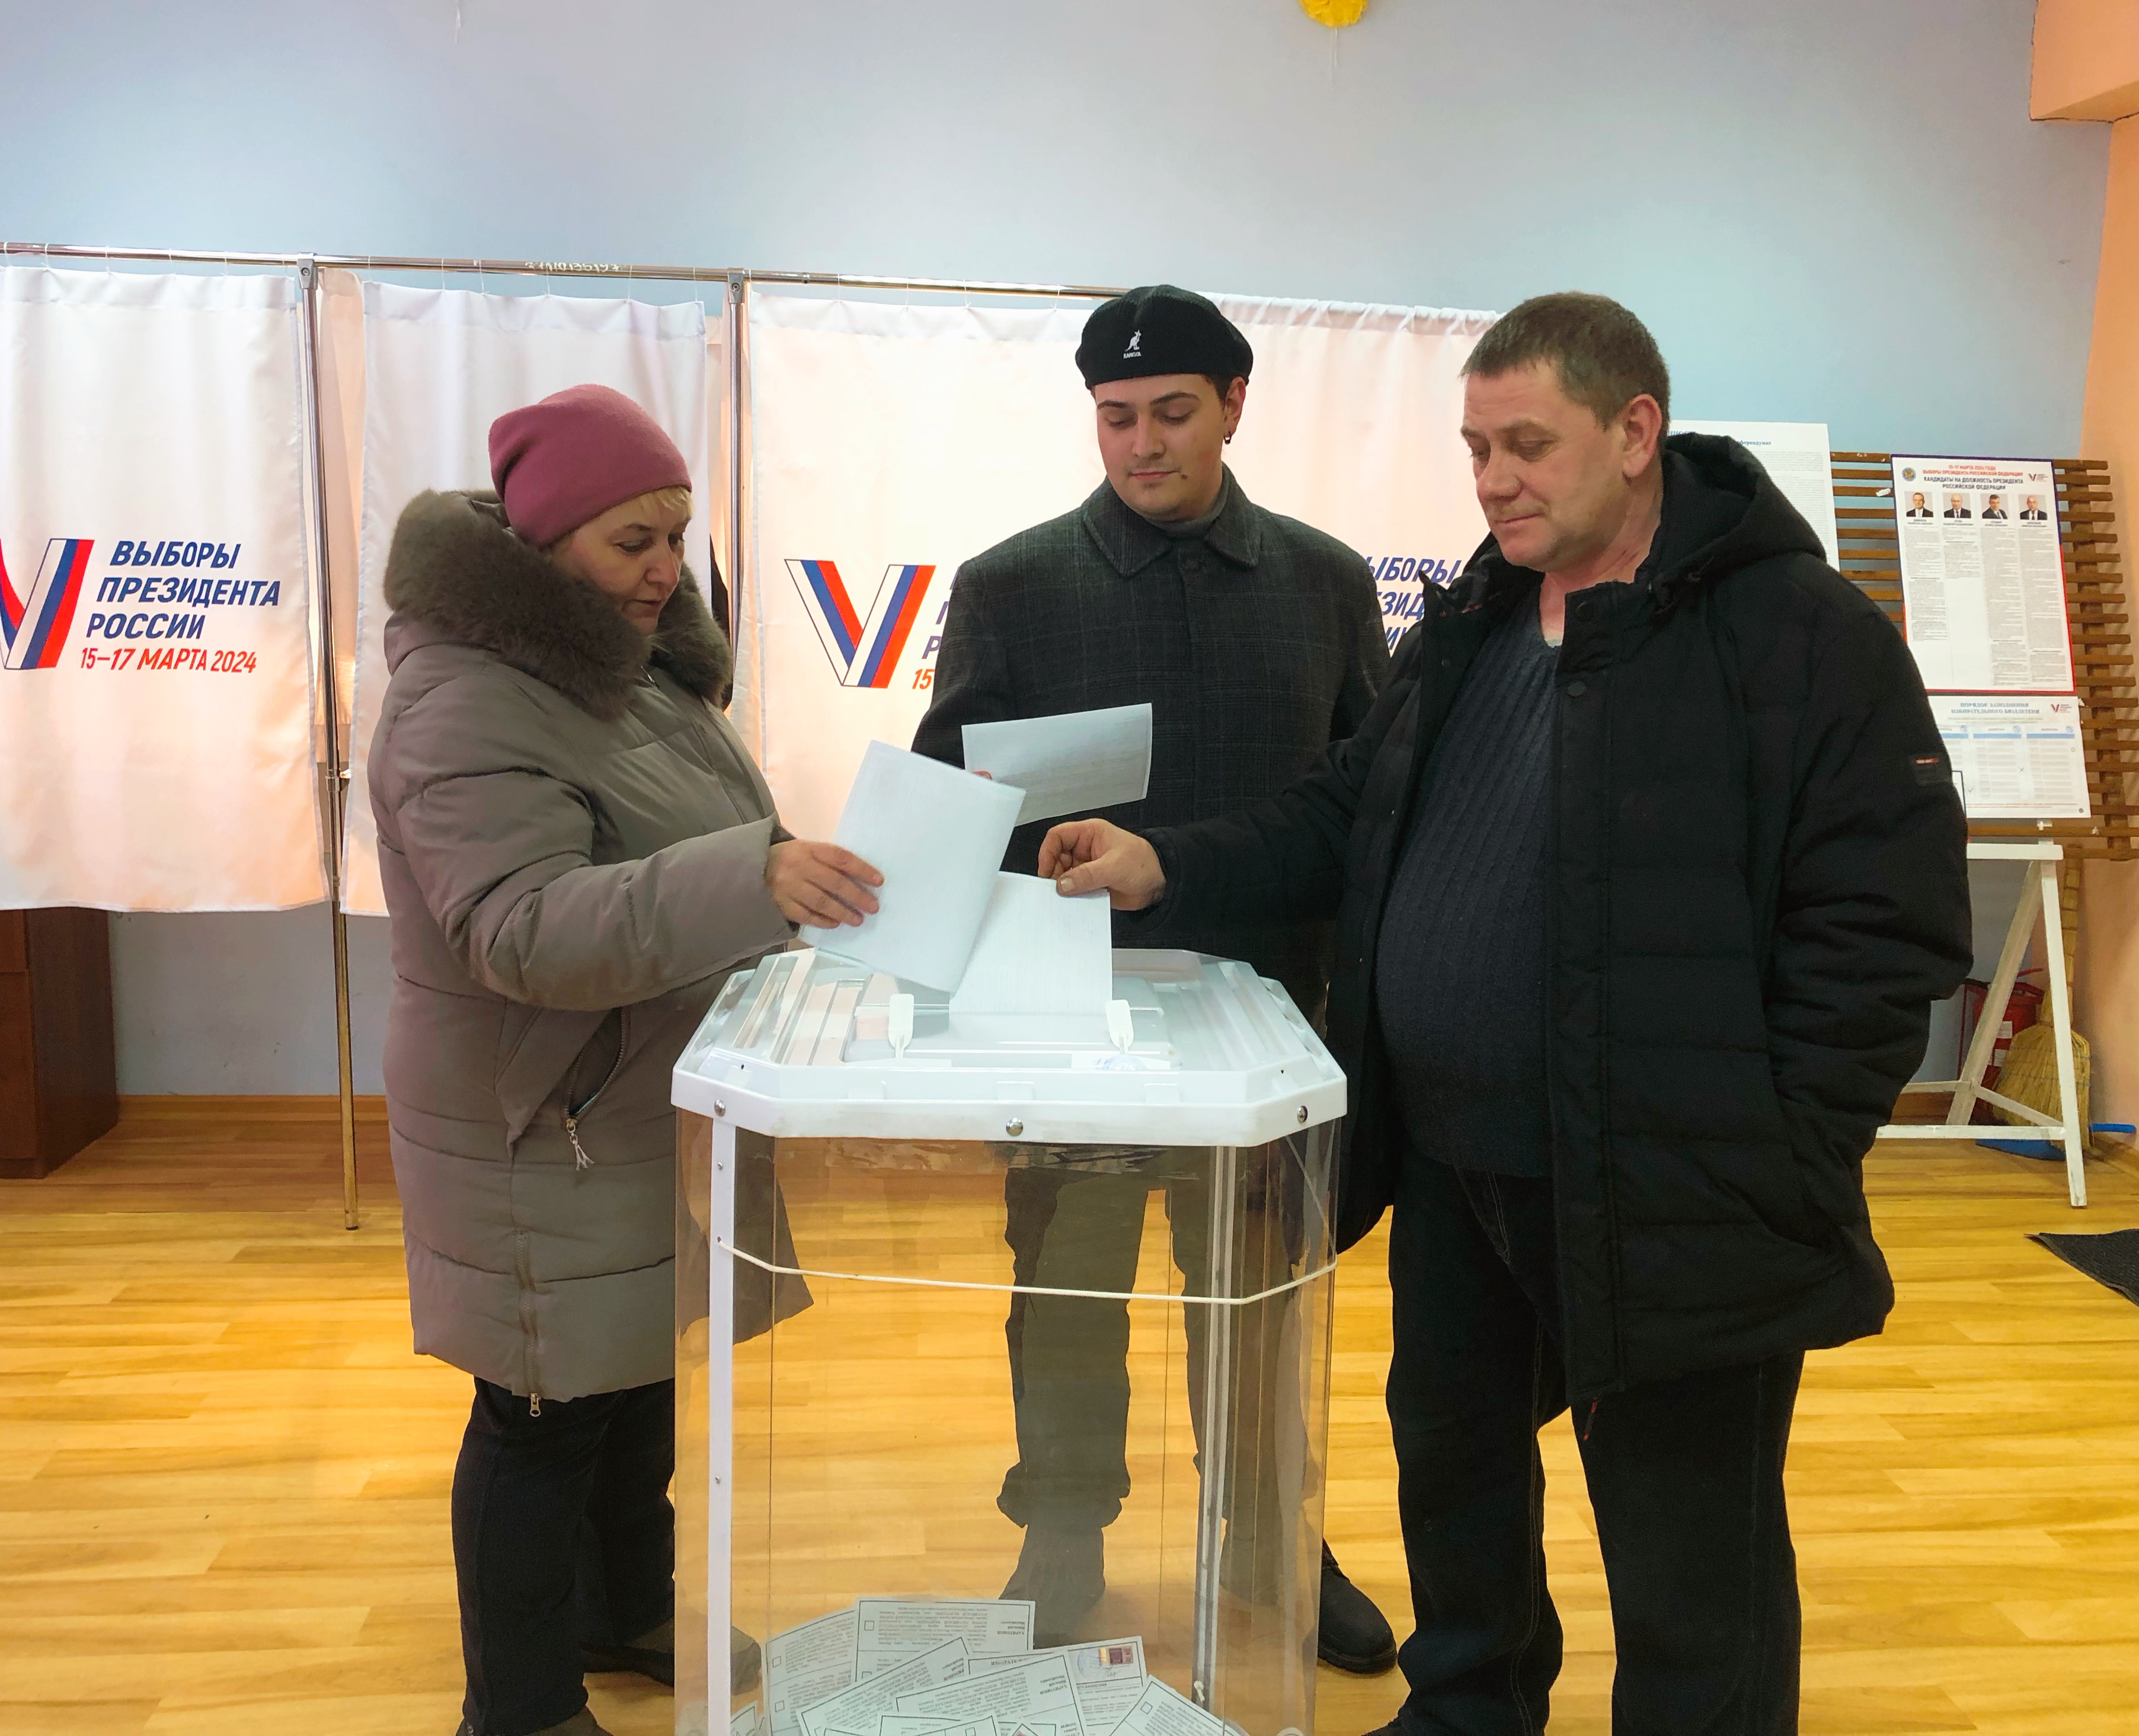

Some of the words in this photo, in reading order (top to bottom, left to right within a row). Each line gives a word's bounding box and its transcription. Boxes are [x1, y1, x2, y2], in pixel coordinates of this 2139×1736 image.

[1123, 351, 1142, 360] KANGOL
[110, 541, 241, 569] ВЫБОРЫ
[1365, 557, 1462, 584] ЫБОРЫ
[96, 577, 282, 608] ПРЕЗИДЕНТА
[86, 613, 206, 640] РОССИИ
[137, 648, 207, 671] МАРТА
[209, 650, 257, 673] 2024
